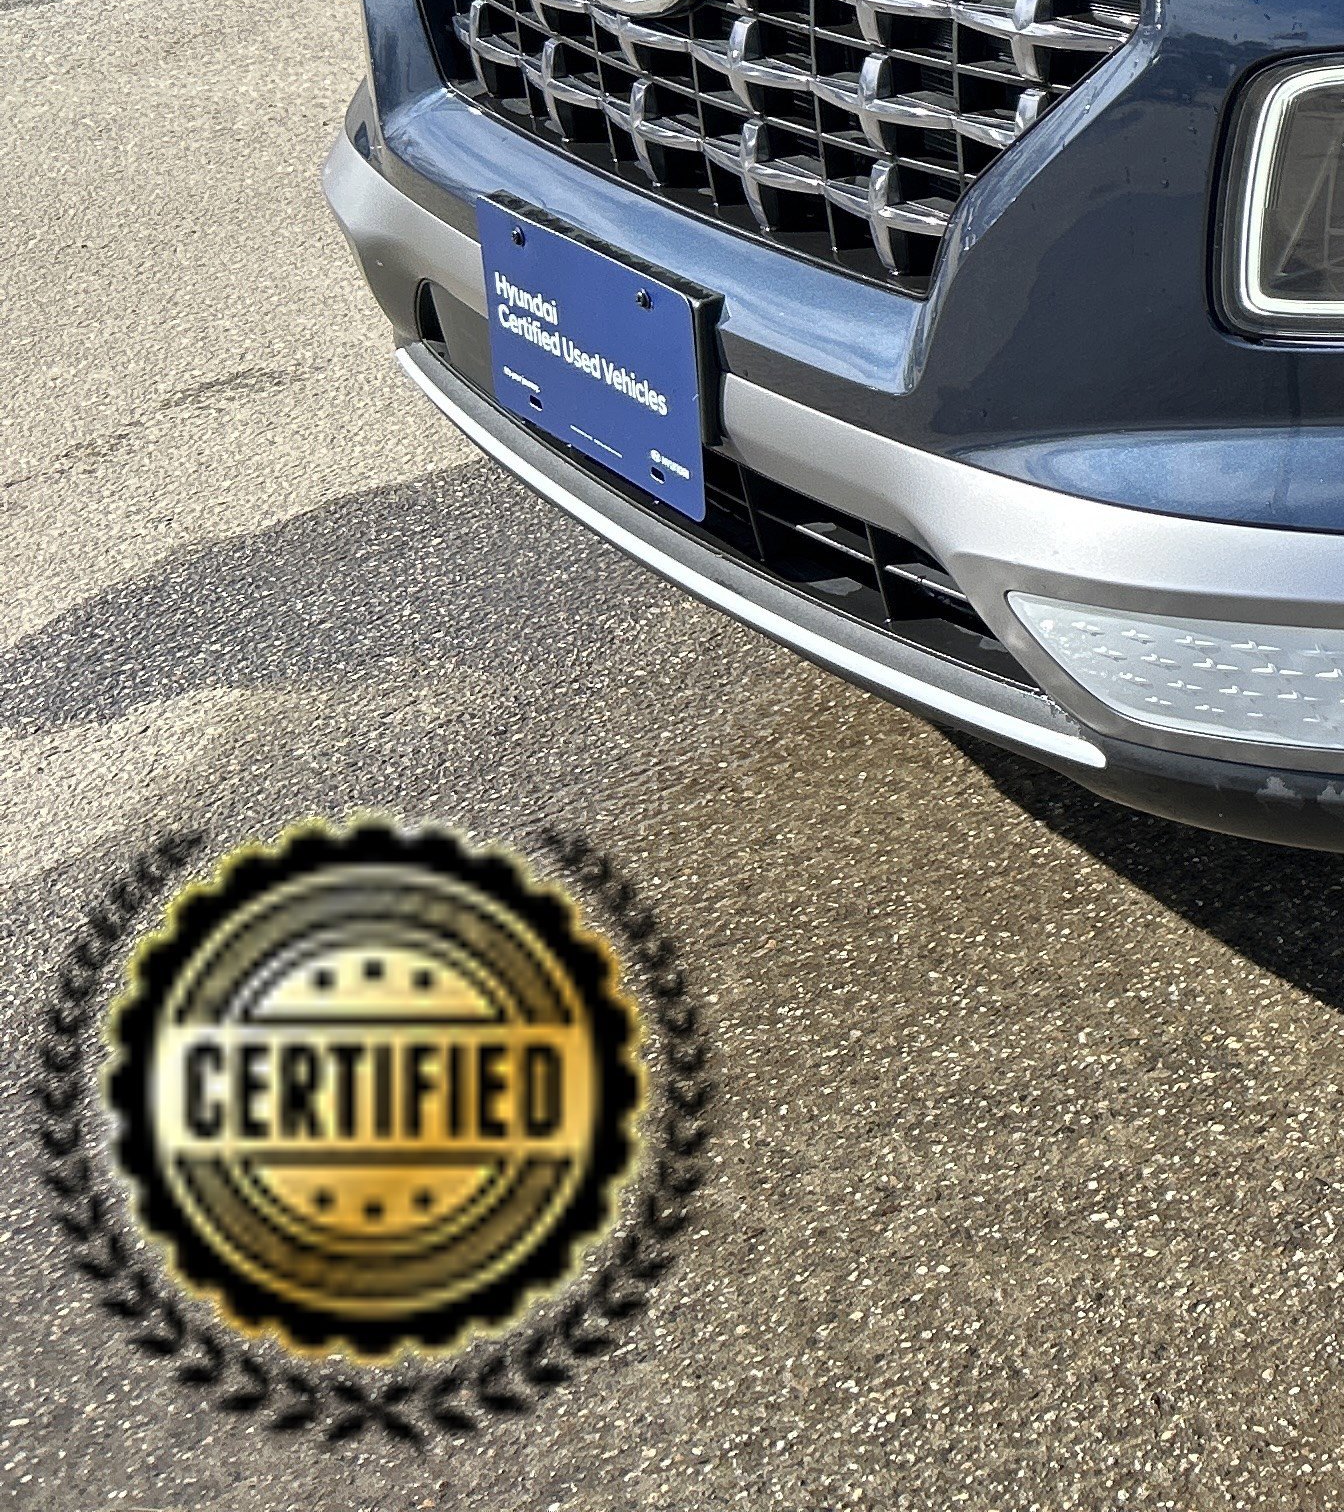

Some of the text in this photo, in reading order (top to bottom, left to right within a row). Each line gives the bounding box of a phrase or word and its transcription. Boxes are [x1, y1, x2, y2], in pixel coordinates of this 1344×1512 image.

[494, 271, 559, 326] Hyundai
[498, 303, 561, 357] Certified
[561, 336, 602, 379] Used
[601, 357, 669, 416] Vehicles
